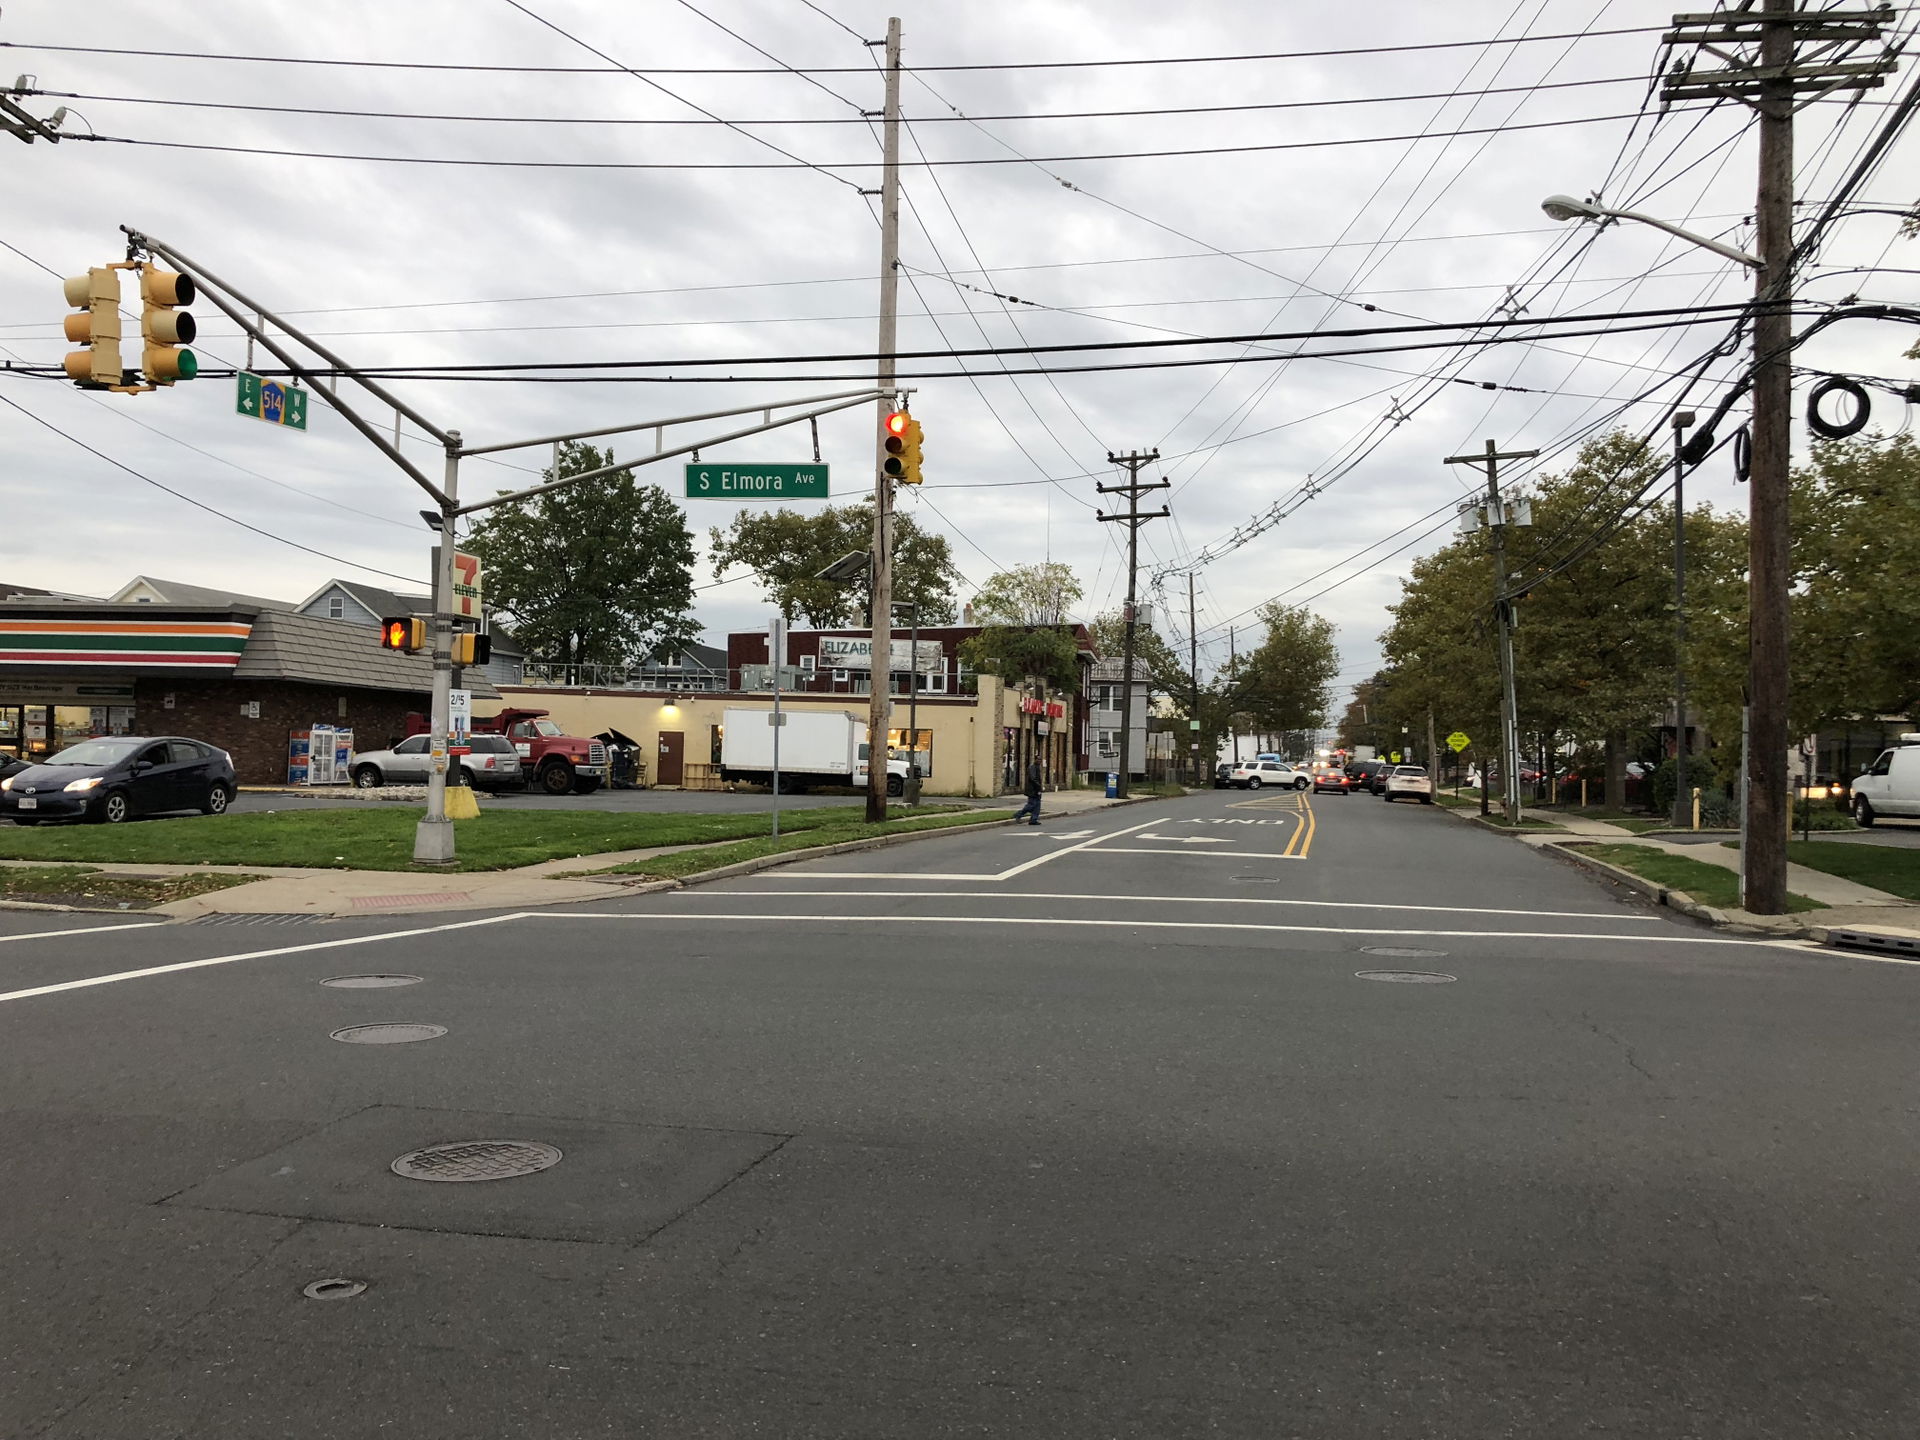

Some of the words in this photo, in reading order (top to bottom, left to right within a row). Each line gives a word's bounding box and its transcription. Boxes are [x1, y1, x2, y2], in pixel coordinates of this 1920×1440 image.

[245, 378, 251, 393] E
[263, 390, 282, 411] 514
[293, 393, 301, 407] W
[699, 471, 710, 490] S
[721, 471, 783, 490] Elmora
[794, 471, 815, 484] Ave
[455, 553, 477, 615] 7
[825, 641, 894, 656] ELIZABE
[1176, 817, 1285, 825] ONLY
